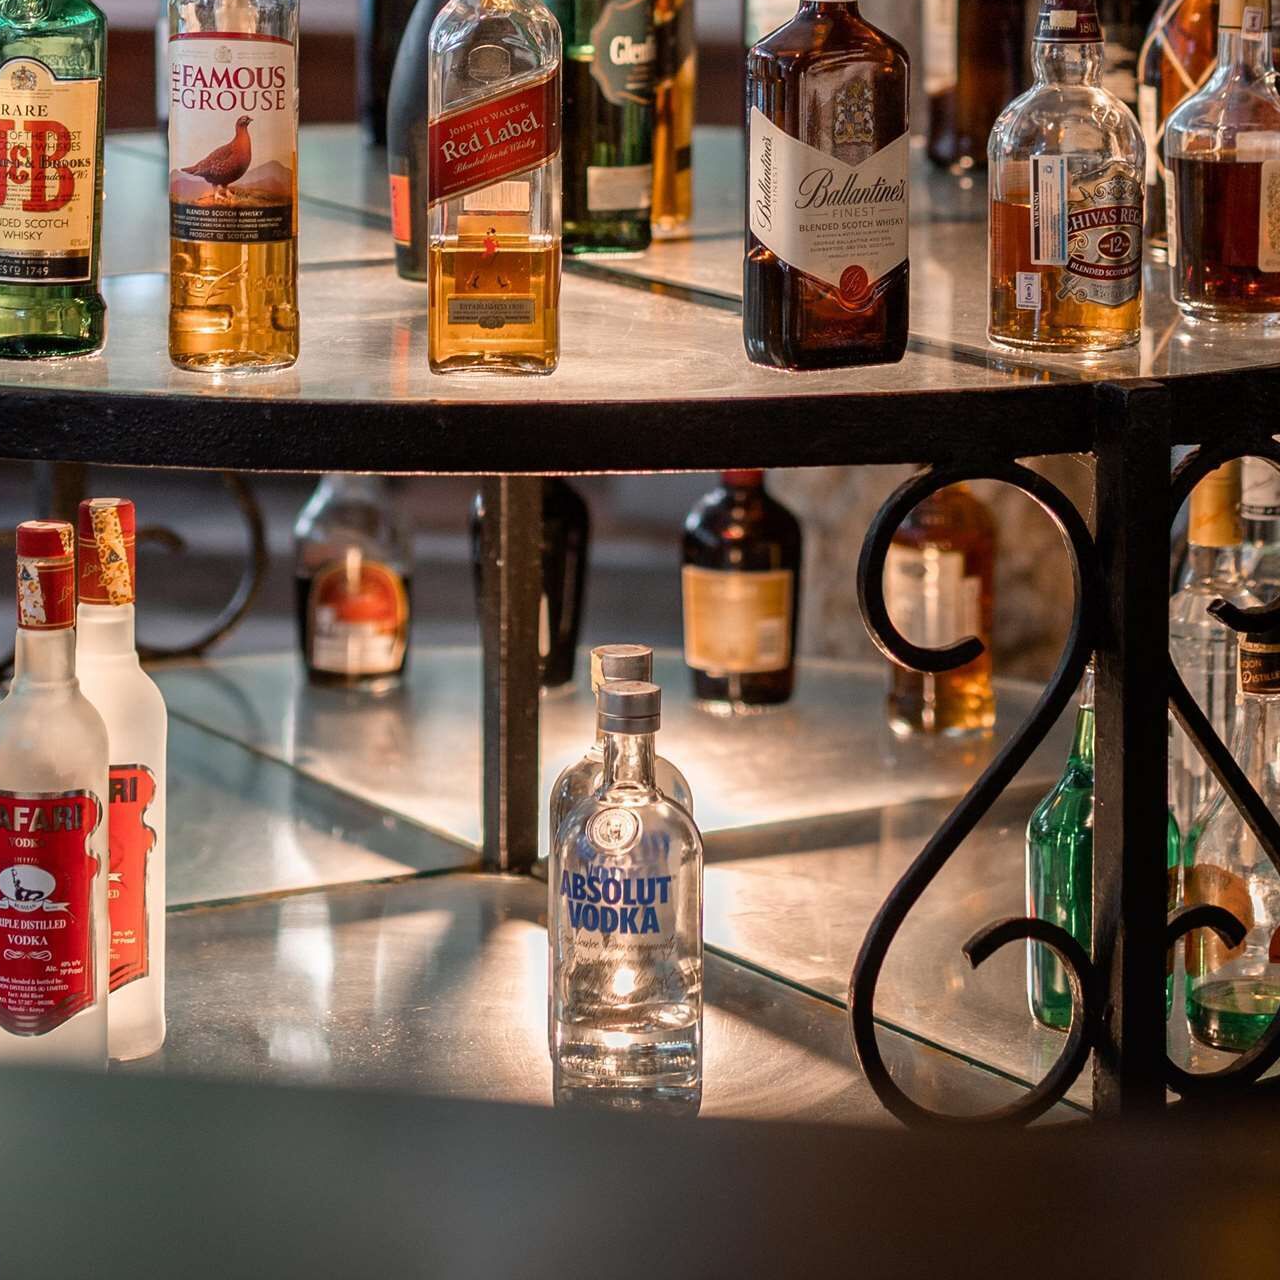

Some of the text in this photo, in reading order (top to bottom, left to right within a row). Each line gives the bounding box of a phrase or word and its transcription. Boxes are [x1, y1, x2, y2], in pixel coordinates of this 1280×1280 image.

[172, 62, 180, 107] THE
[182, 64, 286, 90] FAMOUS
[181, 88, 286, 112] GROUSE
[1, 103, 49, 118] RARE
[448, 115, 490, 139] JOHNNIE
[9, 131, 23, 140] OF
[440, 132, 484, 163] Red
[756, 135, 773, 233] Ballantine's
[795, 167, 906, 209] Ballantine's
[211, 209, 237, 217] SCOTCH
[832, 206, 876, 218] FINEST
[24, 218, 69, 229] SCOTCH
[799, 216, 905, 233] BLENDED SCOTCH WHISKY
[2, 230, 44, 241] WHISKY
[189, 231, 259, 239] PRODUCT OF SCOTLAND
[1109, 235, 1123, 254] 12
[25, 265, 50, 276] 1749
[1070, 261, 1105, 277] BLENDED
[9, 837, 47, 849] VODKA
[560, 869, 672, 906] ABSOLUT
[19, 919, 67, 931] DISTILLED
[568, 900, 660, 934] VODKA
[7, 934, 48, 946] VODKA
